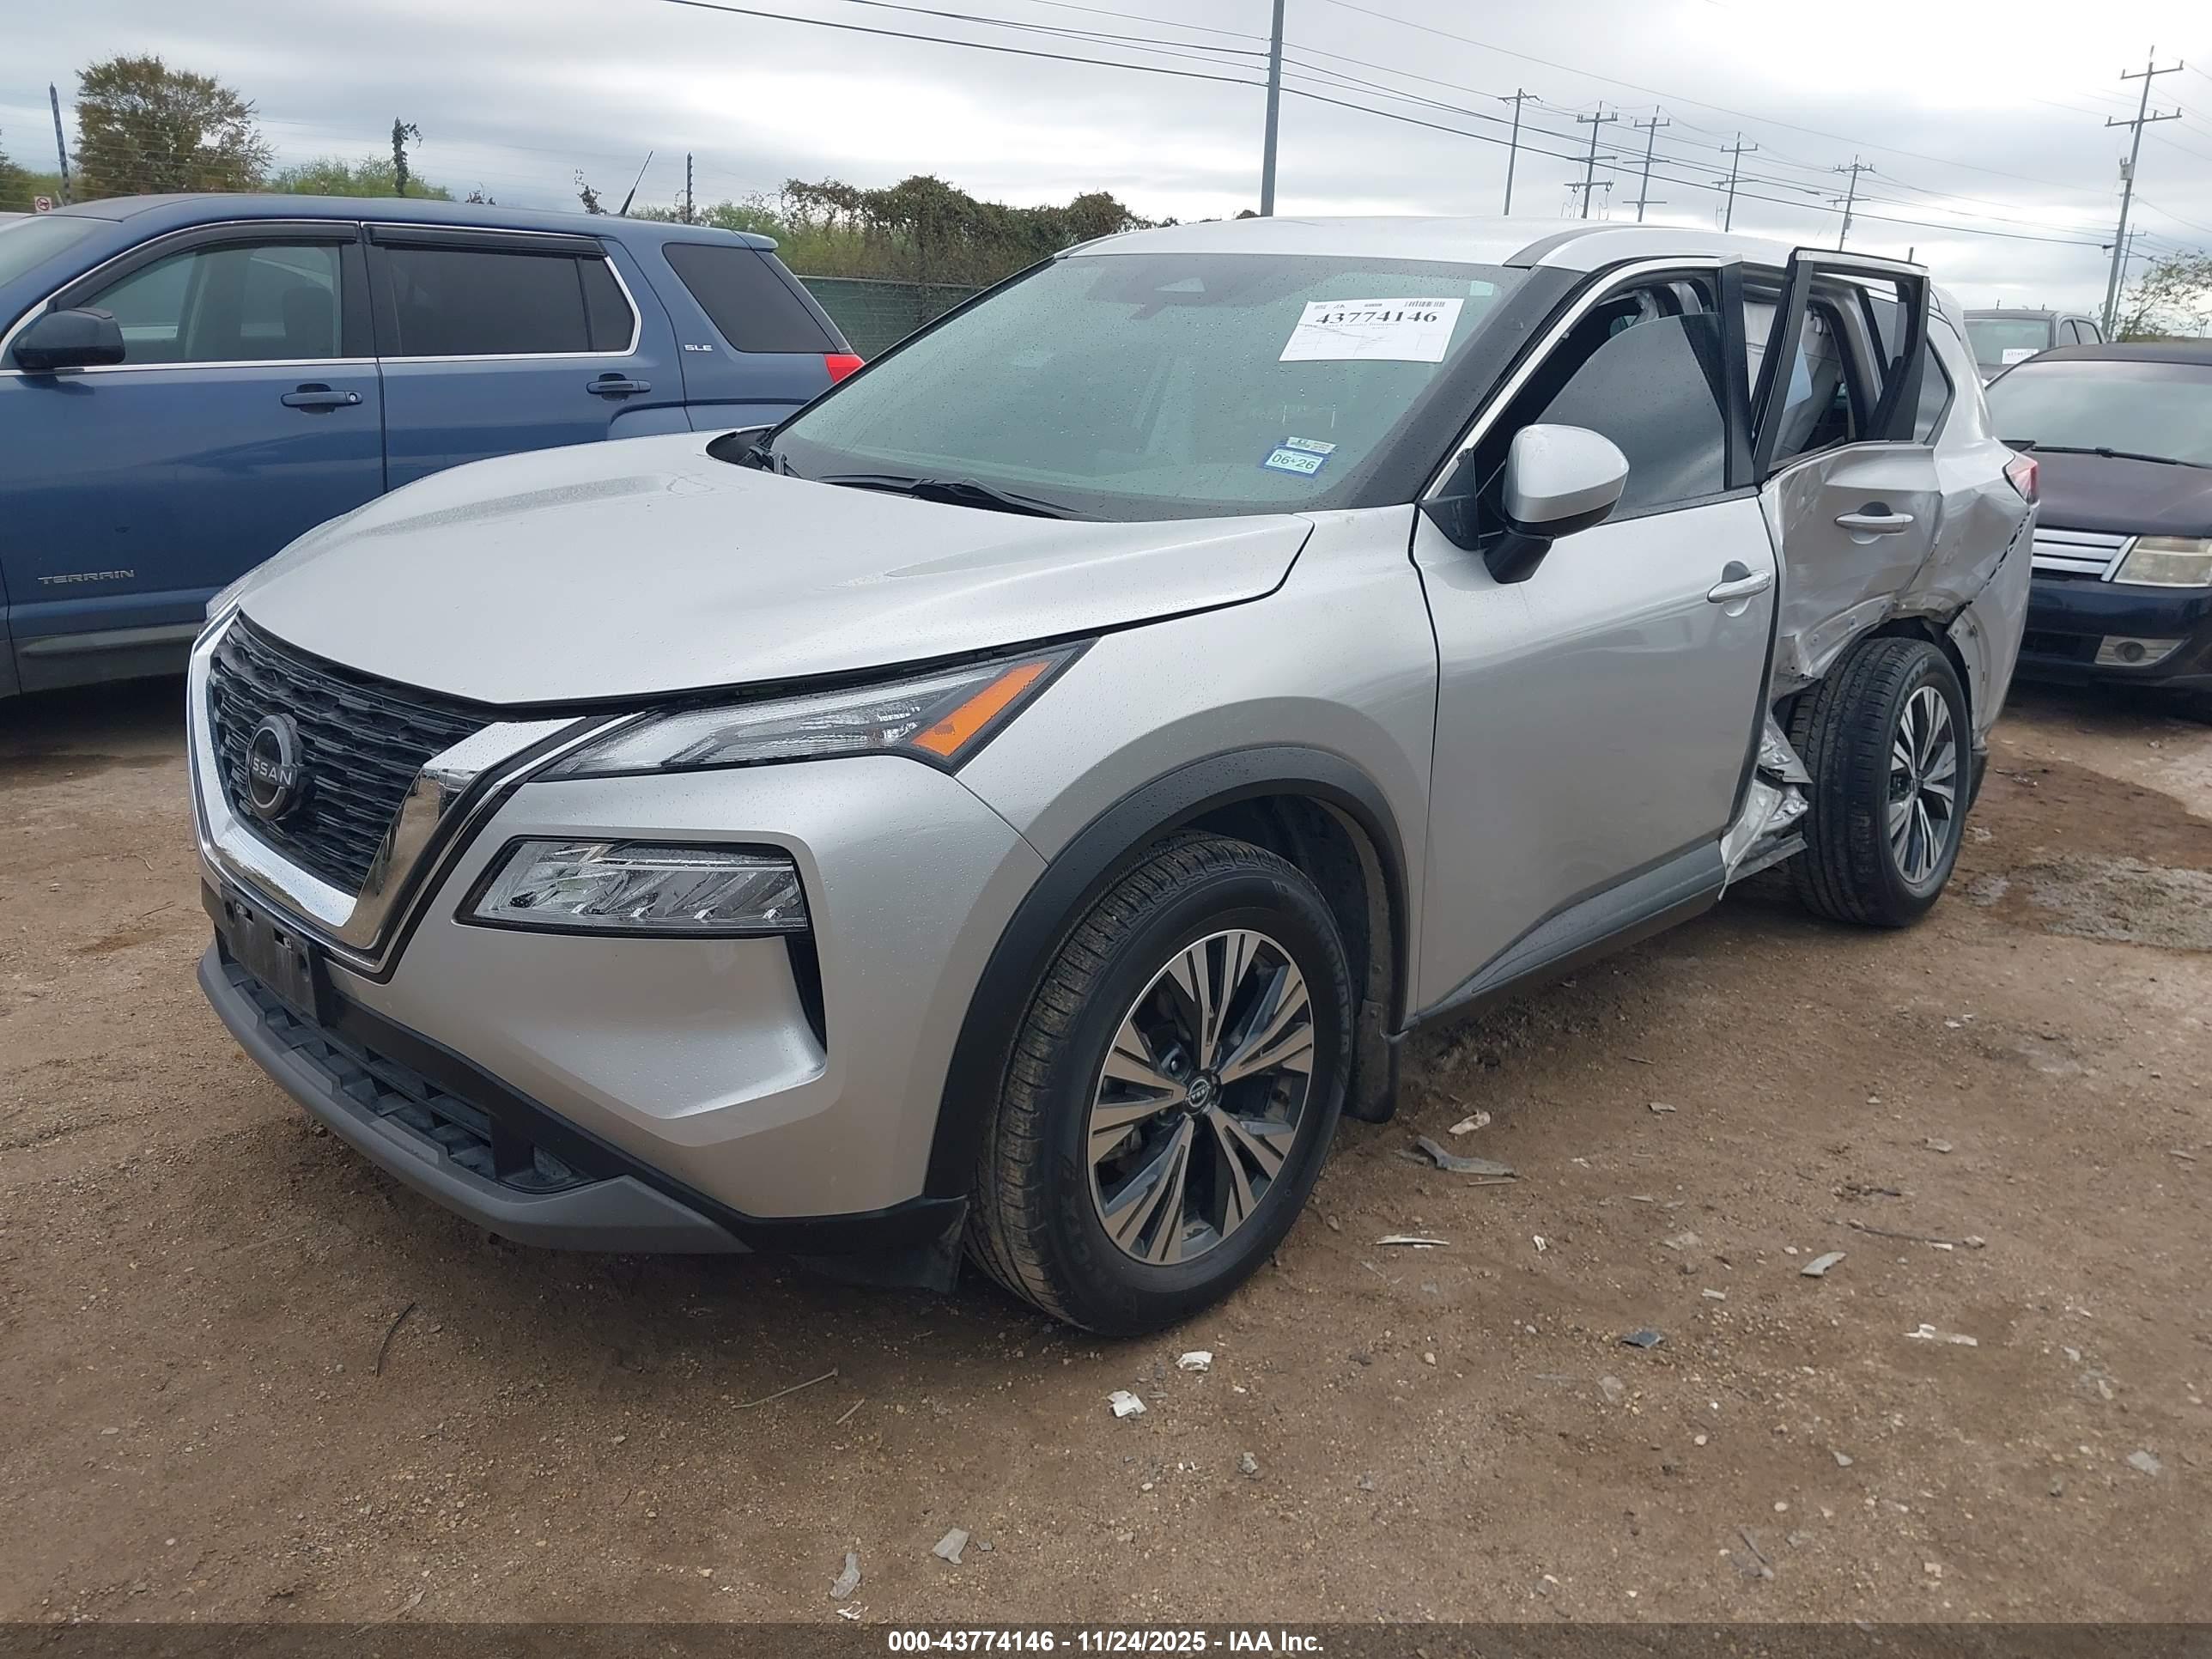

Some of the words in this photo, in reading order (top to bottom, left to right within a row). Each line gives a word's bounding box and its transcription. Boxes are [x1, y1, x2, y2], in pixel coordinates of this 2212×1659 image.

[1316, 311, 1438, 325] 43774146
[1272, 454, 1291, 465] 06
[1295, 459, 1316, 470] 26
[37, 570, 135, 584] TERRAIN
